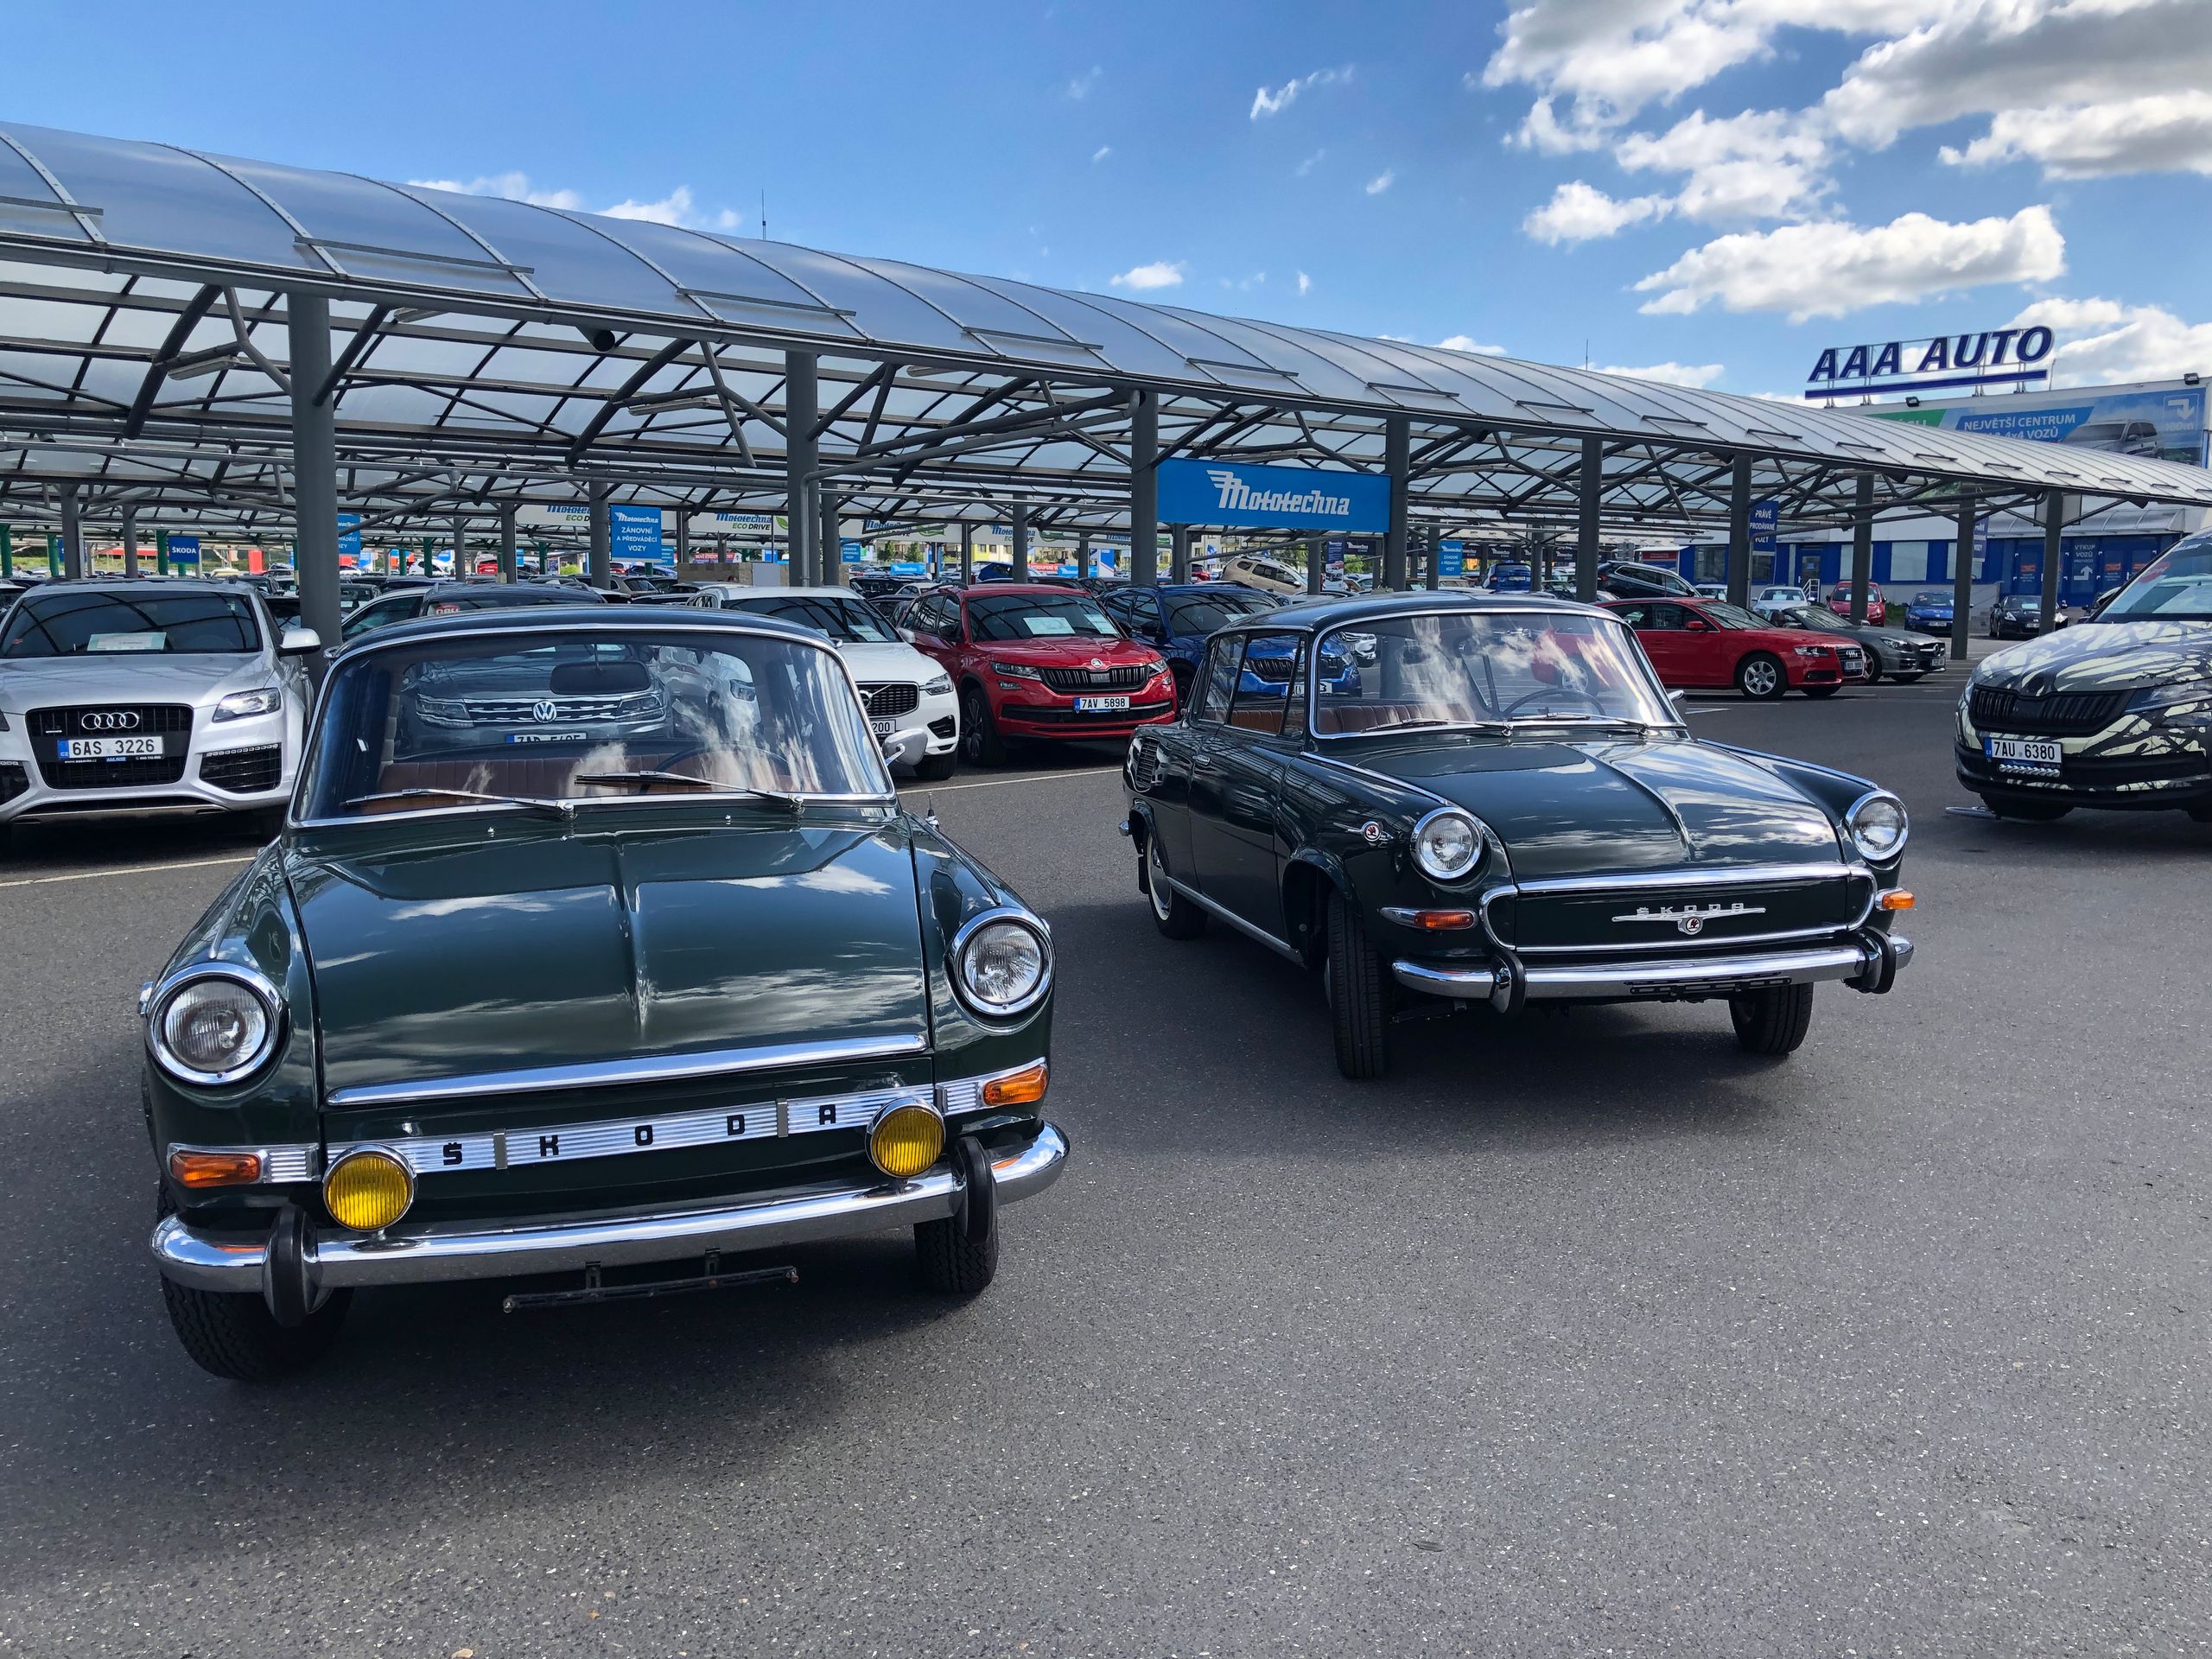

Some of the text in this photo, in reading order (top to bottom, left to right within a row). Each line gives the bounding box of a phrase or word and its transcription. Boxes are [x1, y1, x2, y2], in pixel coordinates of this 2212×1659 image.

[1807, 325, 2056, 384] AAA AUTO
[1964, 414, 2075, 431] NEJVĚTŠÍ CENTRUM
[2027, 426, 2059, 440] VOZŮ
[1206, 470, 1350, 516] Mototechna
[614, 512, 658, 524] Mototechna
[621, 525, 652, 534] ZÁNOVNÍ
[1082, 698, 1098, 709] 7AV
[872, 722, 890, 733] 200
[72, 739, 155, 756] 6AS 3226
[1993, 741, 2055, 760] 7AU 6380
